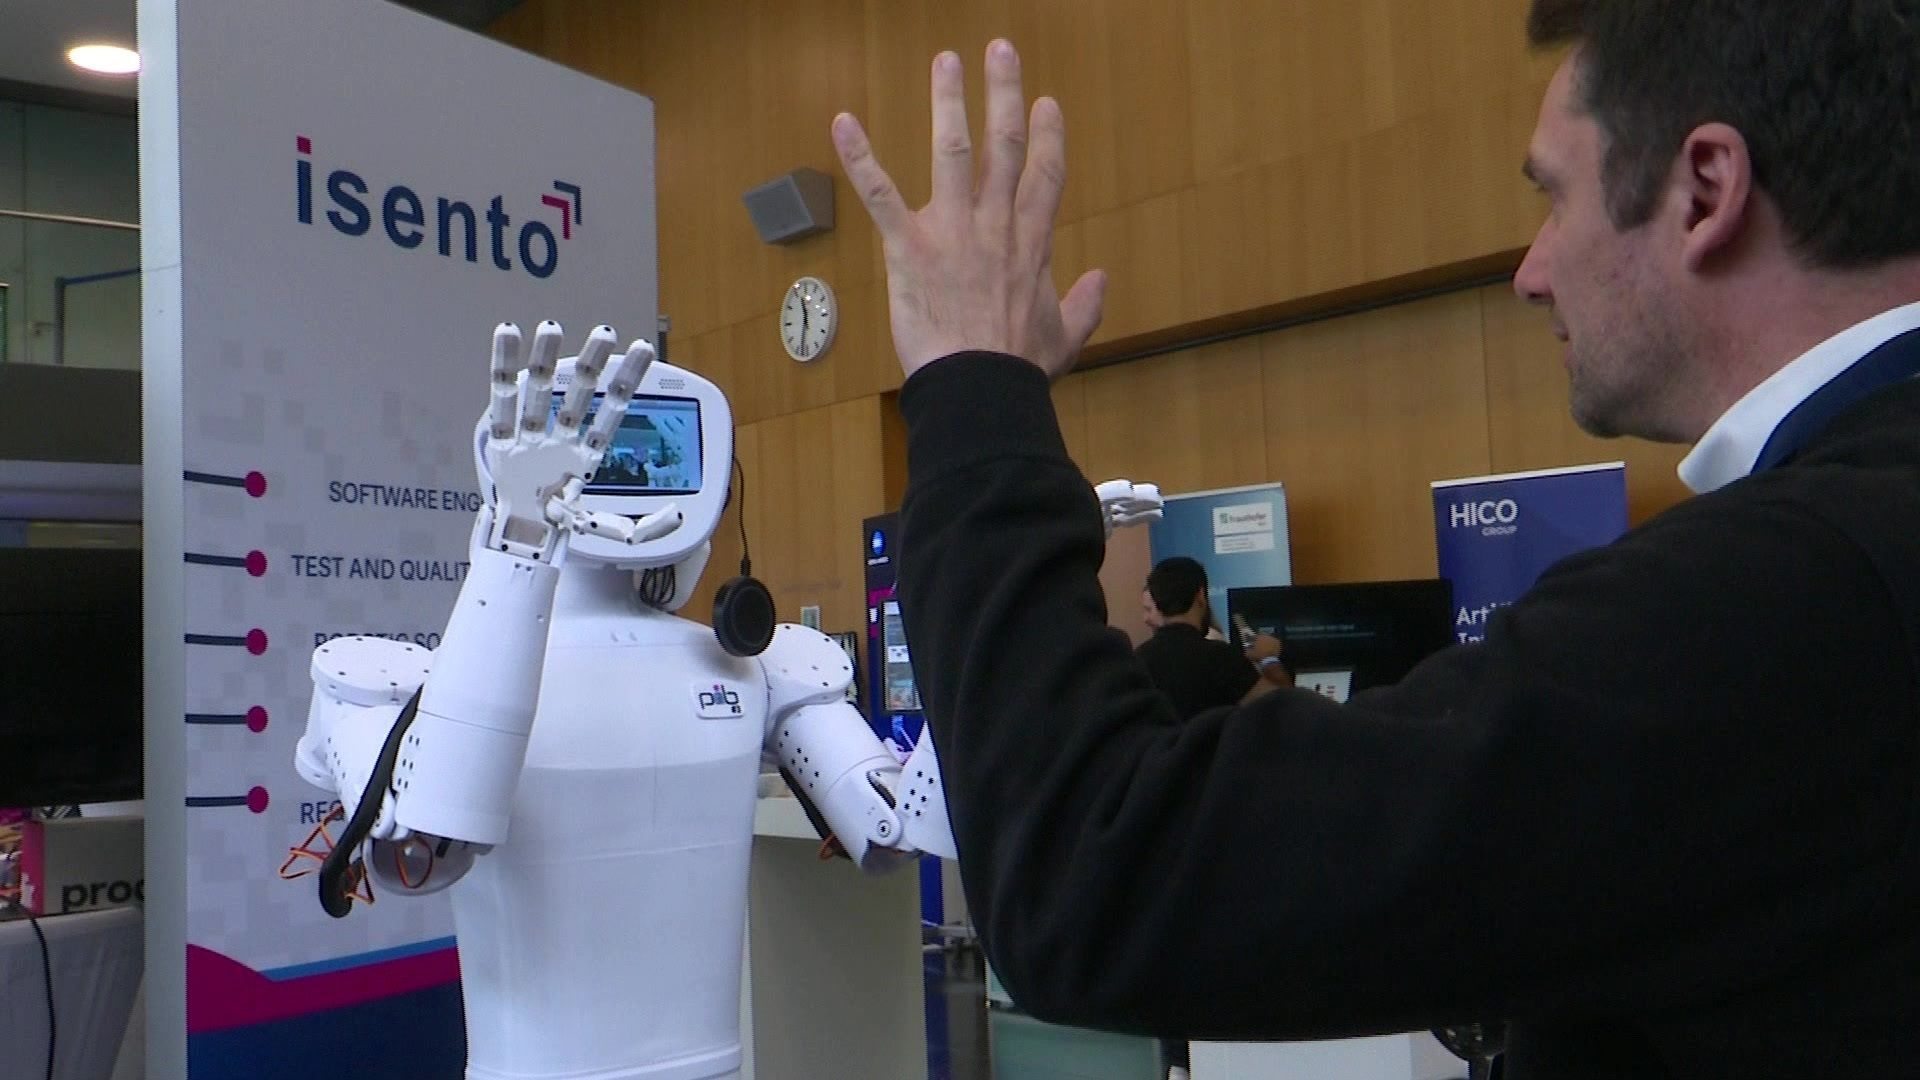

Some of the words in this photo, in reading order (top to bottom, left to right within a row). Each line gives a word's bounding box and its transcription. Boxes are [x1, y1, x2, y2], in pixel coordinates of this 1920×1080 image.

[296, 135, 558, 279] isento
[328, 480, 438, 510] SOFTWARE
[442, 490, 484, 513] ENG
[1450, 498, 1518, 528] HICO
[291, 554, 345, 578] TEST
[348, 557, 396, 580] AND
